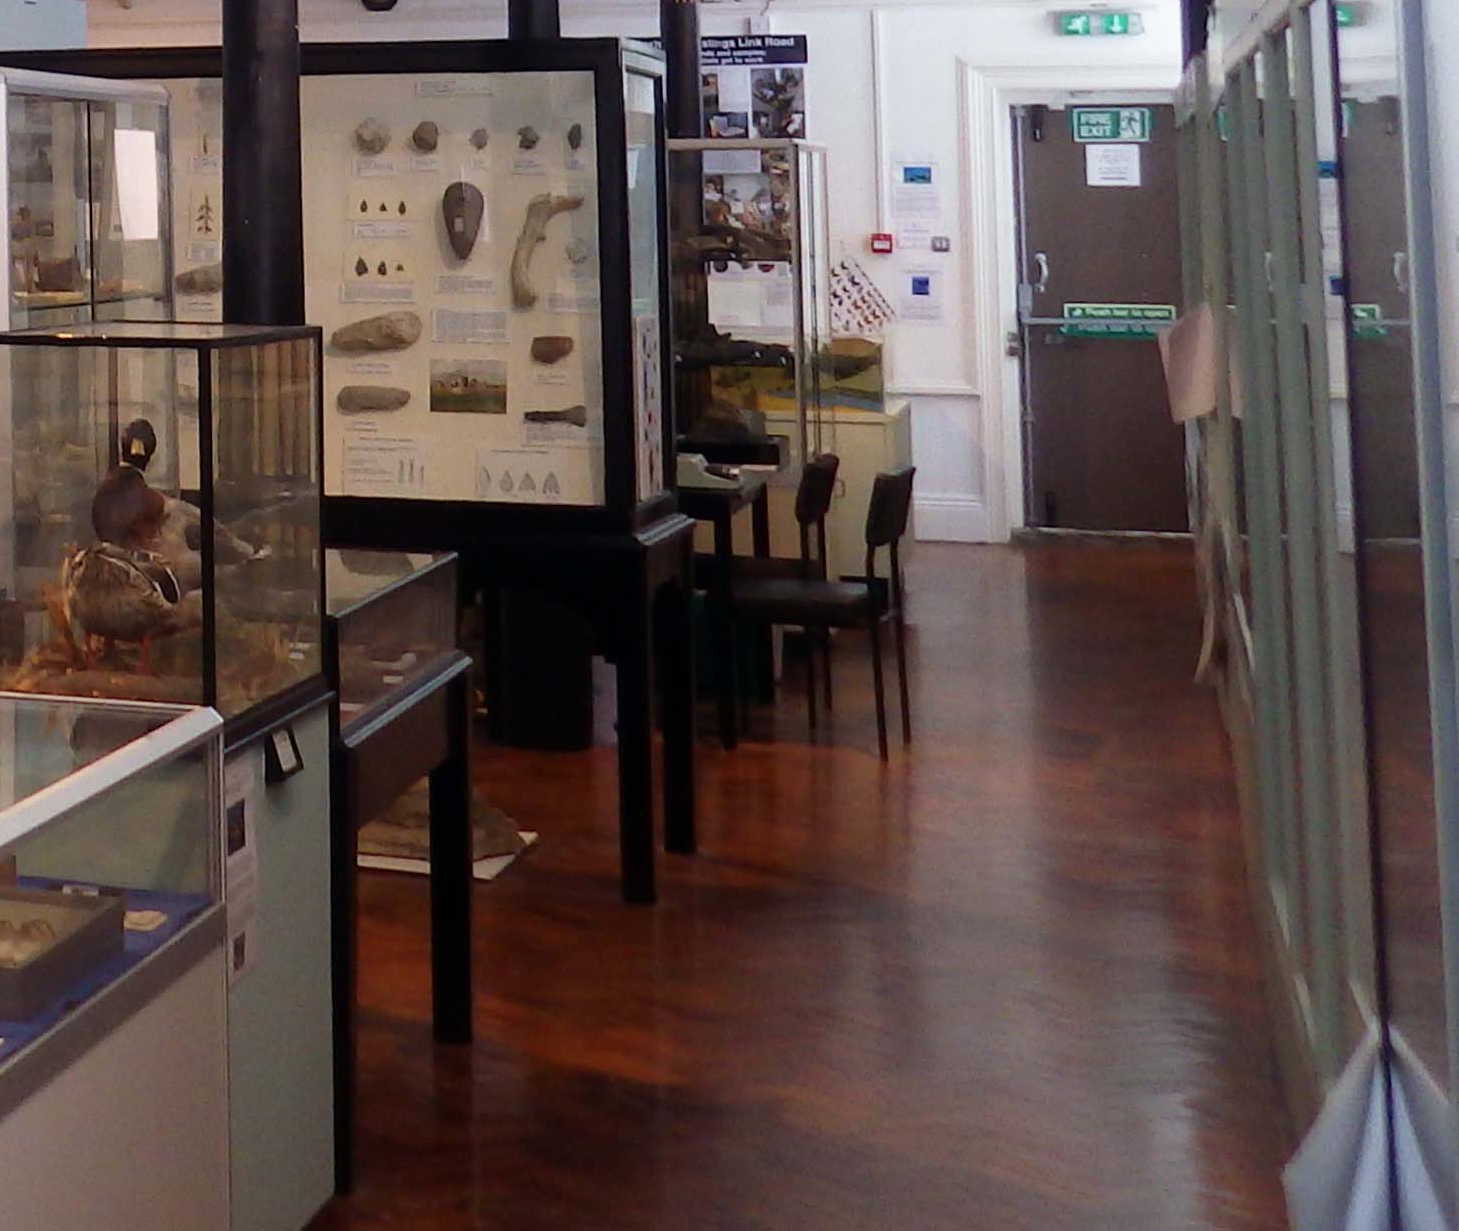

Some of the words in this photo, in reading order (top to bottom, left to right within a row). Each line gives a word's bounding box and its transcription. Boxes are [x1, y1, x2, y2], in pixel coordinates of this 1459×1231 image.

[738, 38, 762, 47] Link
[764, 37, 795, 47] Road
[1080, 113, 1111, 125] FIRE
[1080, 126, 1111, 137] EXIT
